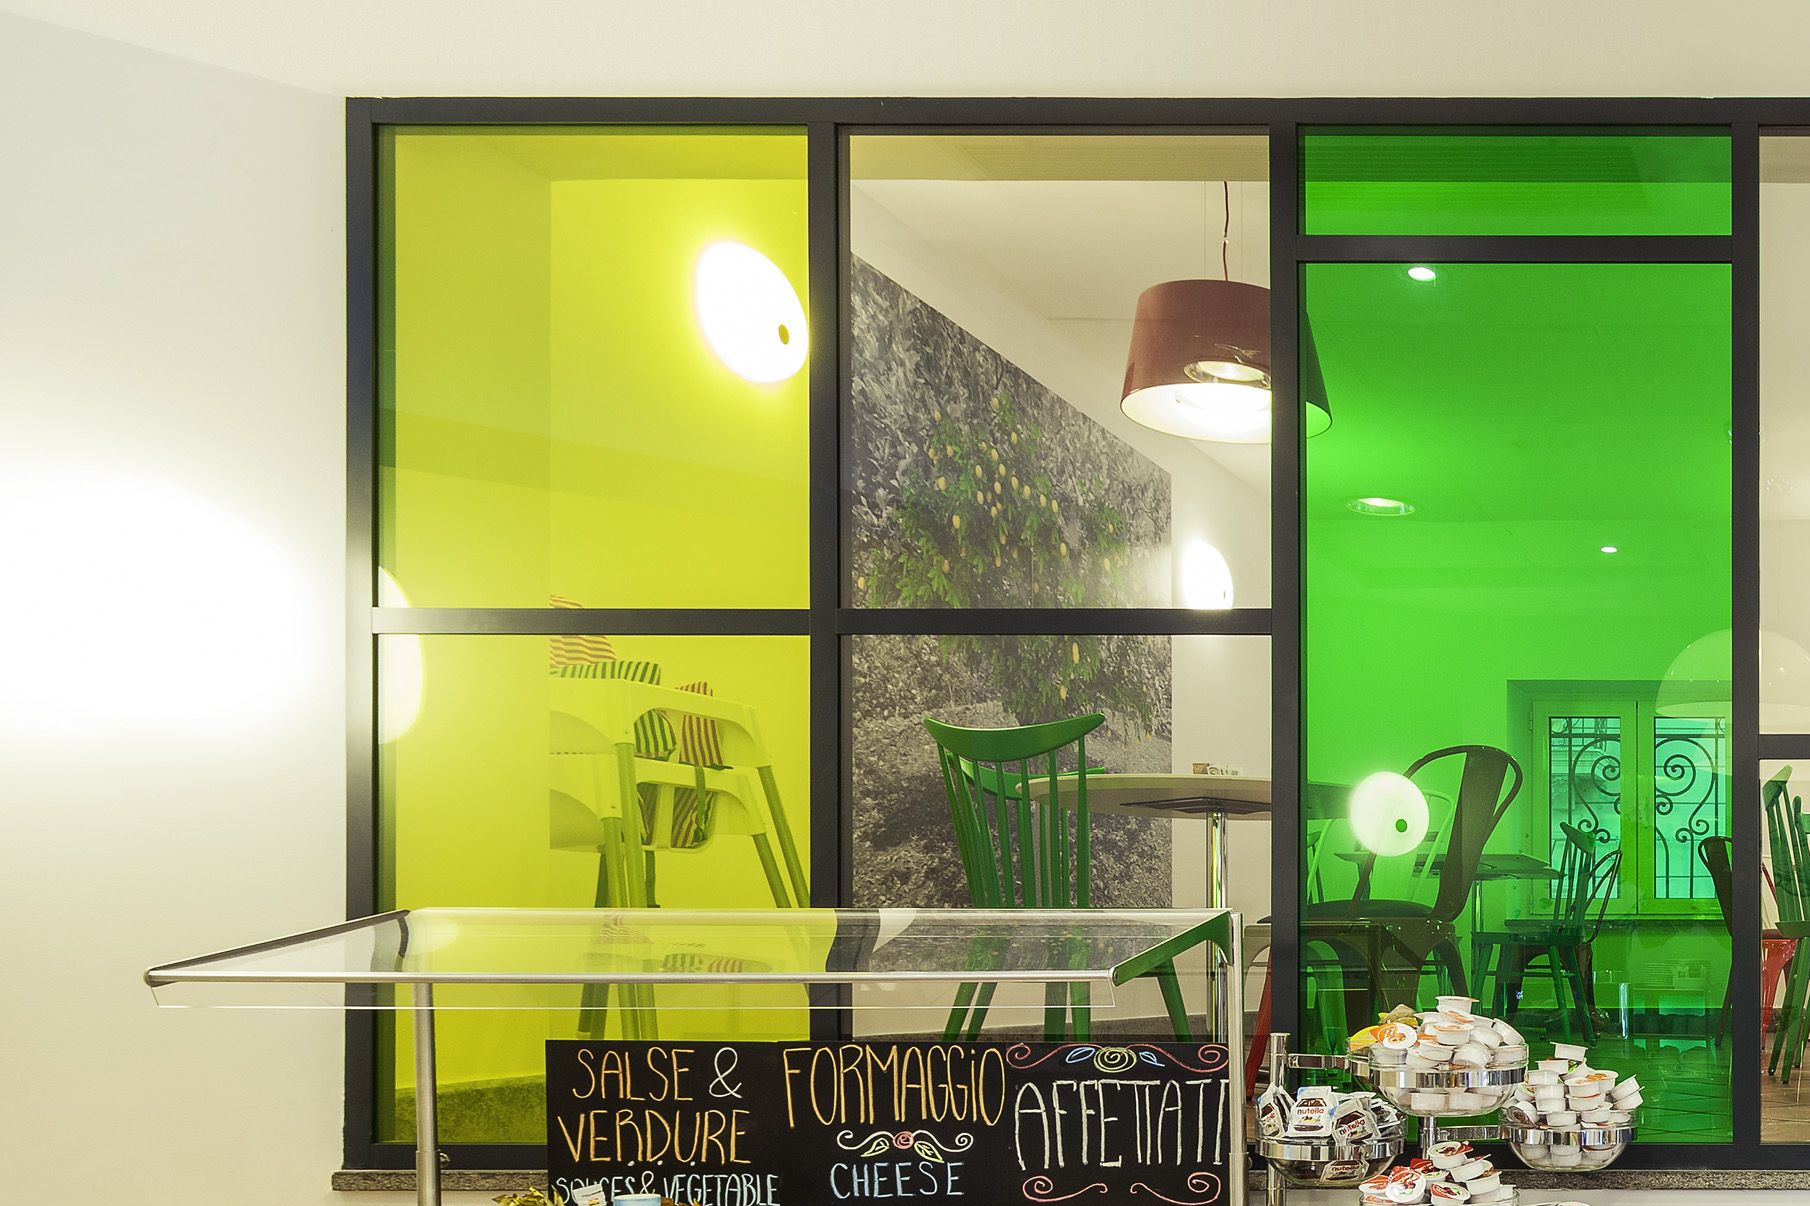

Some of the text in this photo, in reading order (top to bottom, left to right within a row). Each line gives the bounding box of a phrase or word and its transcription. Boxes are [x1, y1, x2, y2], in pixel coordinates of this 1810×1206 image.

[572, 1046, 743, 1101] SALSE &
[1296, 1107, 1325, 1115] nutella
[1338, 1118, 1366, 1136] nutella
[557, 1108, 752, 1165] VERDURE
[829, 1161, 965, 1199] CHEESE
